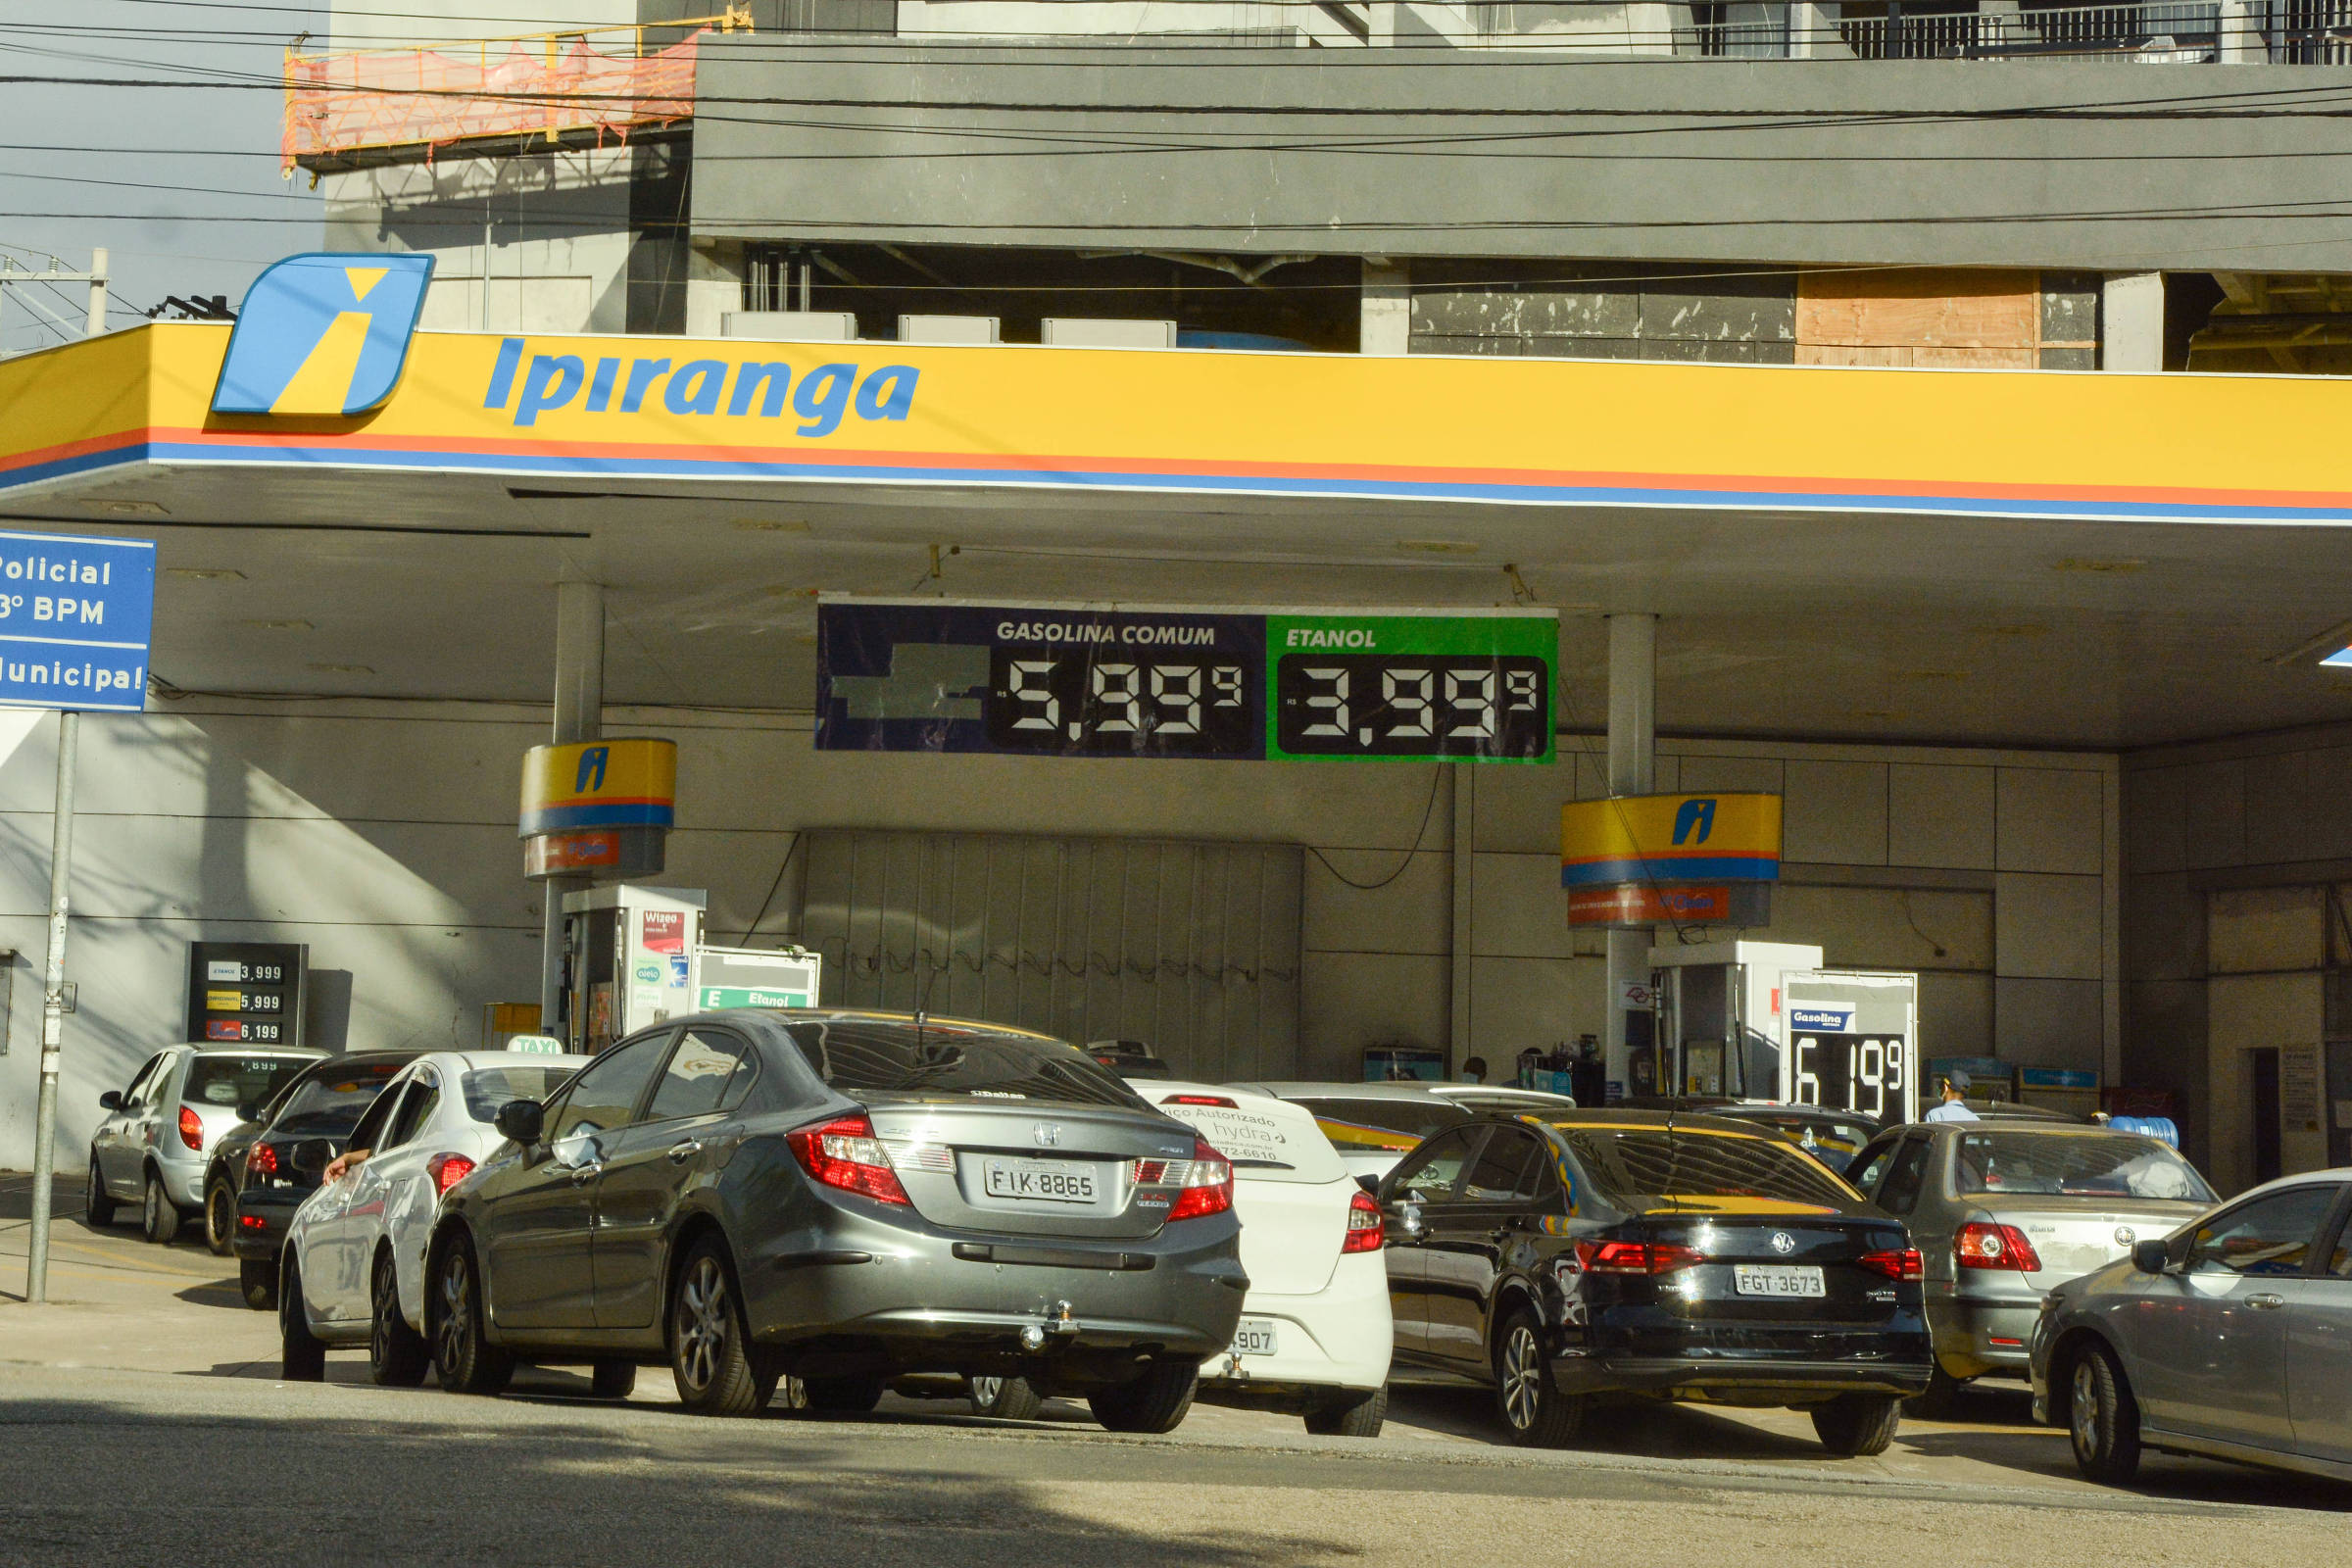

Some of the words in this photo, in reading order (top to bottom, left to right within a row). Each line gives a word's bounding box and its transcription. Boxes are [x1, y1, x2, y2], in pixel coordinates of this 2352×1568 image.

[483, 338, 921, 438] Ipiranga
[0, 557, 111, 585] olicial
[34, 596, 104, 625] BPM
[997, 621, 1115, 643] GASOLINA
[1122, 626, 1215, 646] COMUM
[1286, 628, 1376, 648] ETANOL
[708, 990, 721, 1007] E
[749, 992, 789, 1007] Etanol
[1793, 1011, 1841, 1023] Gasolina
[241, 1024, 278, 1041] 6,199
[517, 1039, 557, 1055] TAXI
[1196, 1108, 1276, 1128] Autorizado
[1213, 1122, 1271, 1141] hydra
[1238, 1332, 1271, 1349] 907
